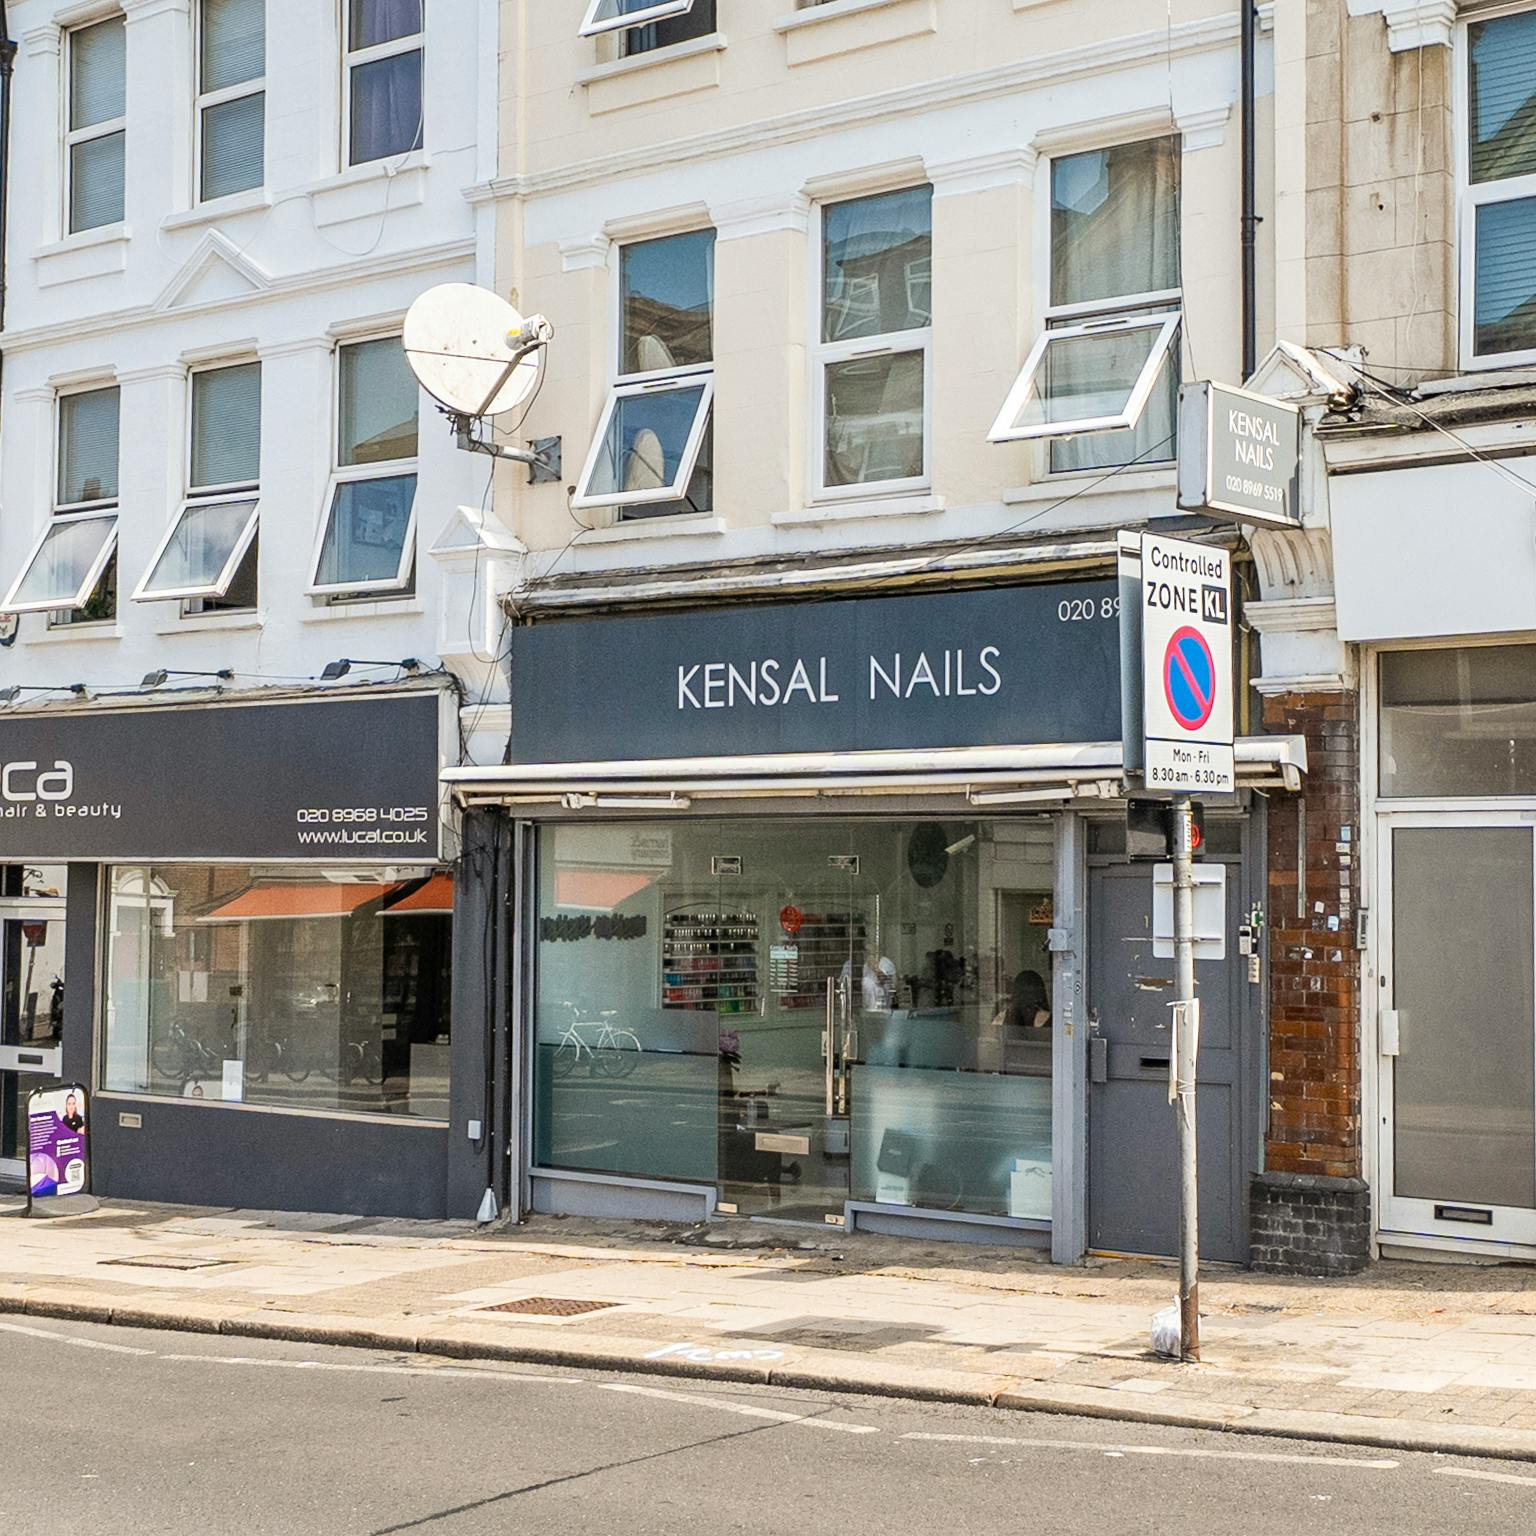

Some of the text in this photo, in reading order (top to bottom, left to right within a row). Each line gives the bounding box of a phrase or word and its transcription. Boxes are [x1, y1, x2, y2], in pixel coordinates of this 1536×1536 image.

[1229, 409, 1280, 446] KENSAL
[1235, 439, 1274, 470] NAILS
[1225, 475, 1283, 502] 020 8969 5519
[1151, 546, 1222, 579] Controlled
[1058, 598, 1095, 621] 020
[1147, 581, 1225, 619] ZONE KL
[677, 646, 1002, 710] KENSAL NAILS
[1173, 748, 1192, 762] Mon
[1198, 750, 1210, 764] Fri
[1152, 767, 1174, 782] 8.30
[1194, 769, 1215, 784] 6.30
[35, 804, 47, 817] &
[54, 802, 122, 819] beauty
[297, 807, 428, 822] 020 8968 4025
